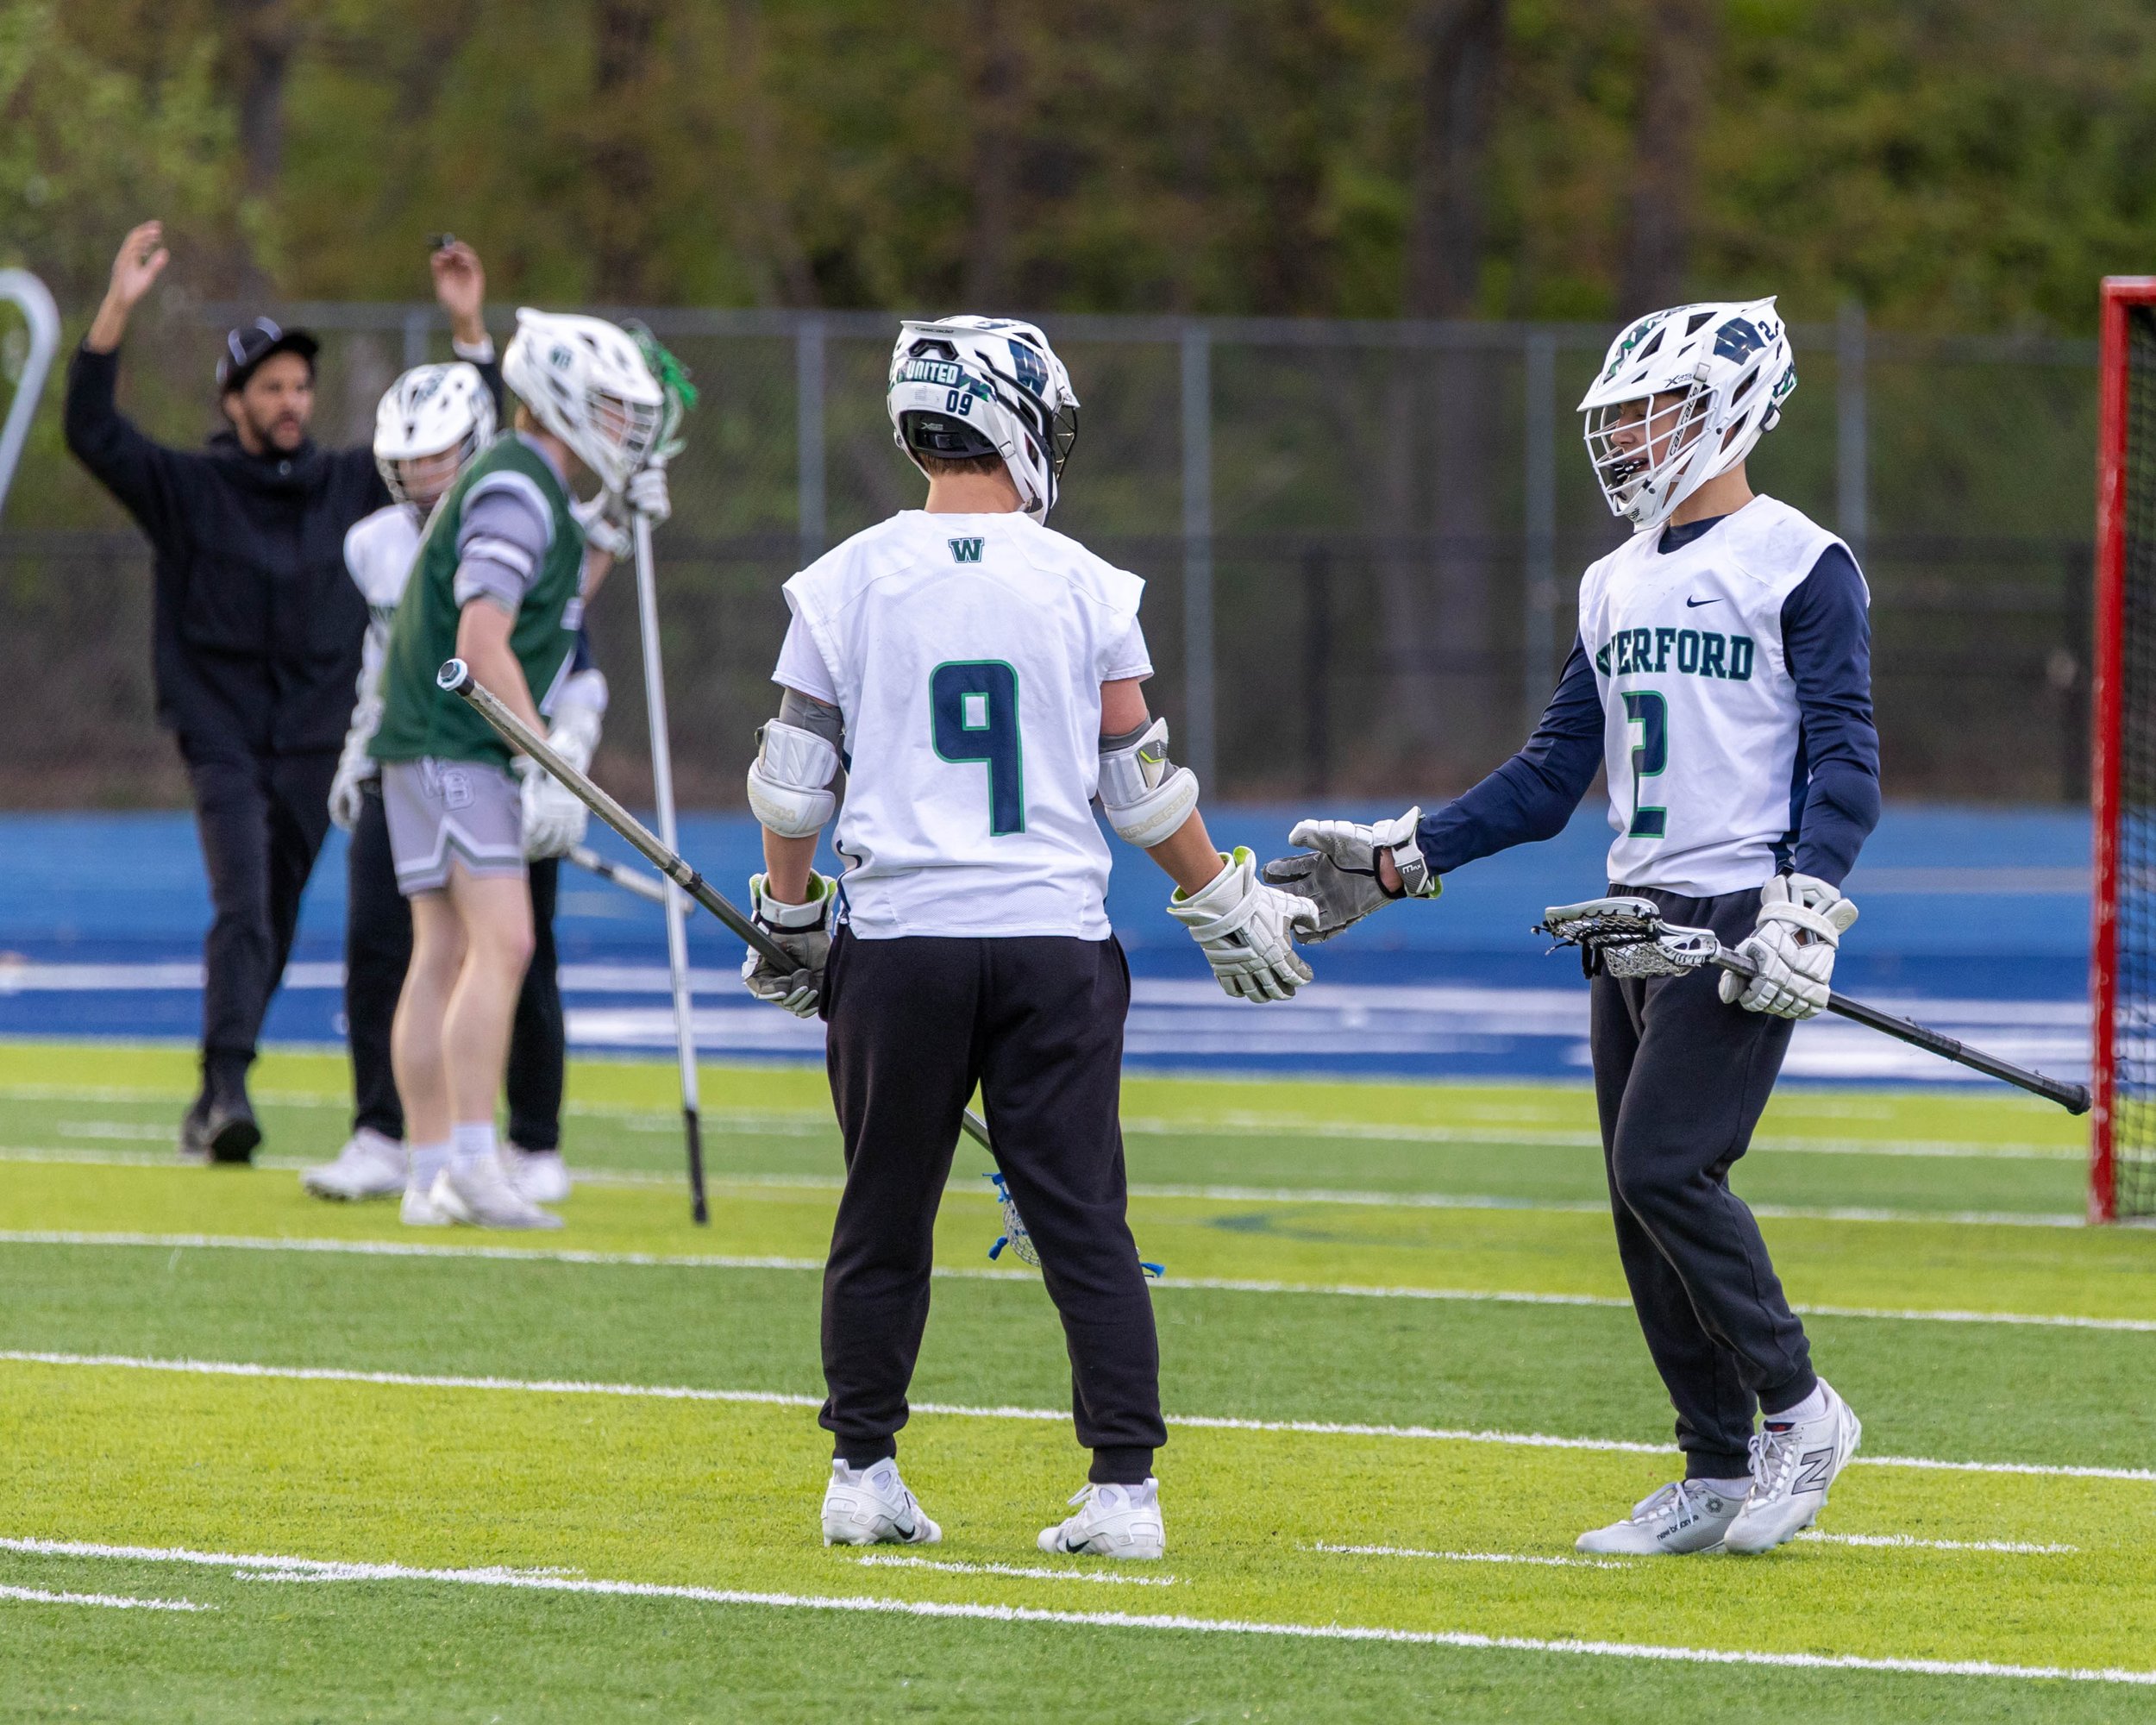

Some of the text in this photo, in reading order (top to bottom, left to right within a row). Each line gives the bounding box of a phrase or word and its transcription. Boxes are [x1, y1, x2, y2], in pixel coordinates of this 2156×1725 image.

[1758, 321, 1775, 342] 2
[906, 360, 959, 385] UNITED
[945, 389, 974, 417] 09
[948, 536, 984, 563] W
[929, 659, 1025, 837] 9
[1620, 689, 1669, 839] 2
[1669, 1515, 1700, 1534] baane
